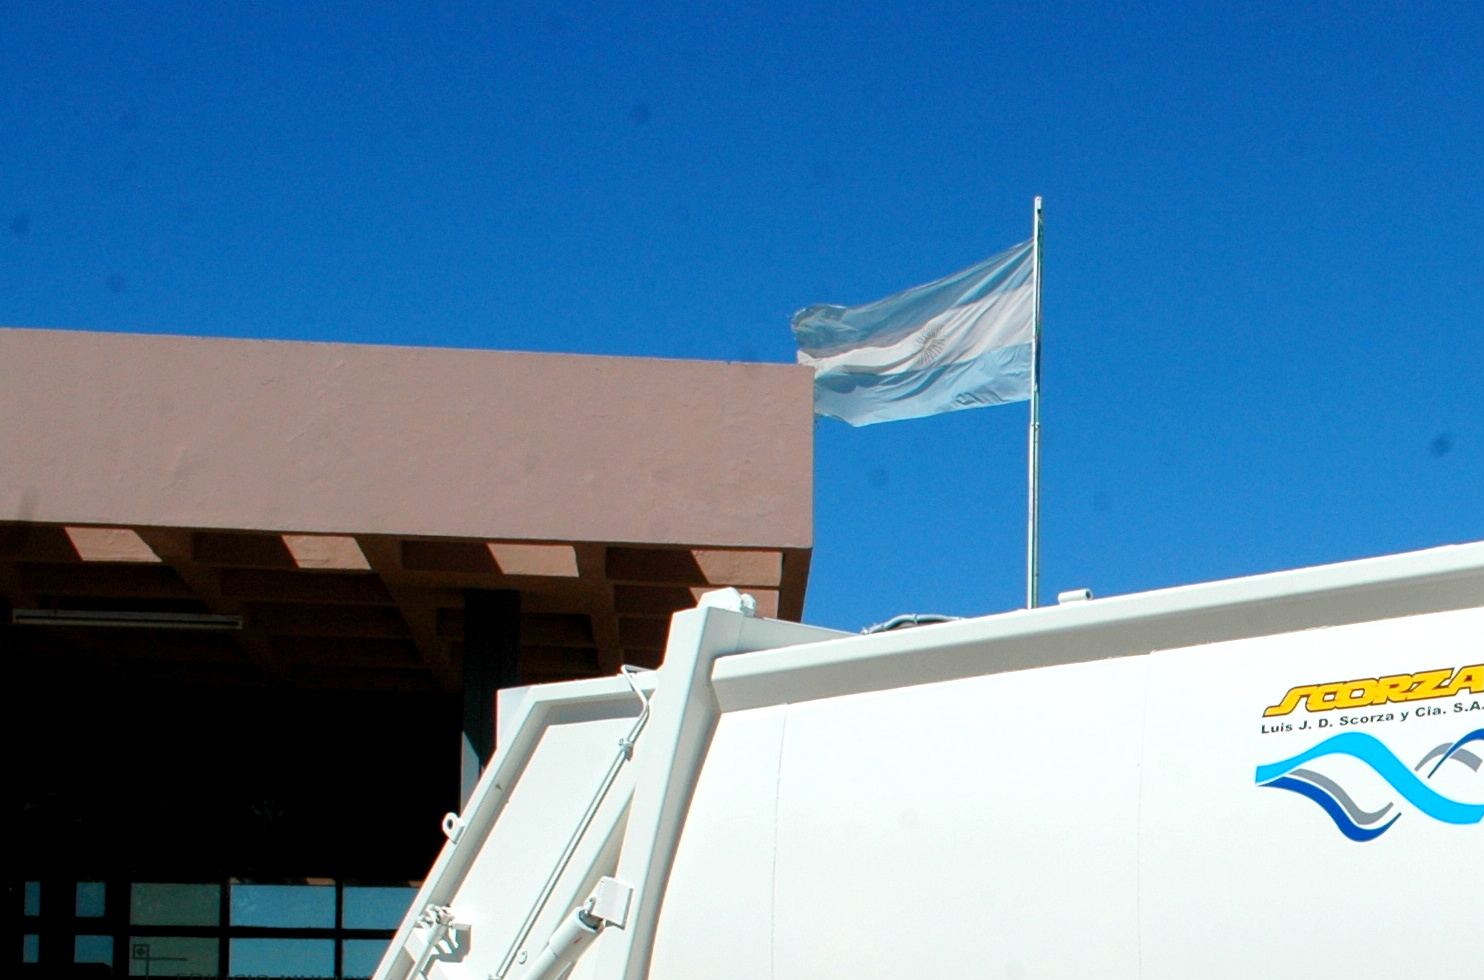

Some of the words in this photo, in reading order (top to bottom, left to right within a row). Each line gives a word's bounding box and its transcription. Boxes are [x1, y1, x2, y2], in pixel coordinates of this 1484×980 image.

[1261, 722, 1293, 734] Luis
[1299, 720, 1312, 730] J.
[1318, 718, 1333, 728] D.
[1339, 711, 1394, 726] Scorza
[1400, 711, 1409, 722] y
